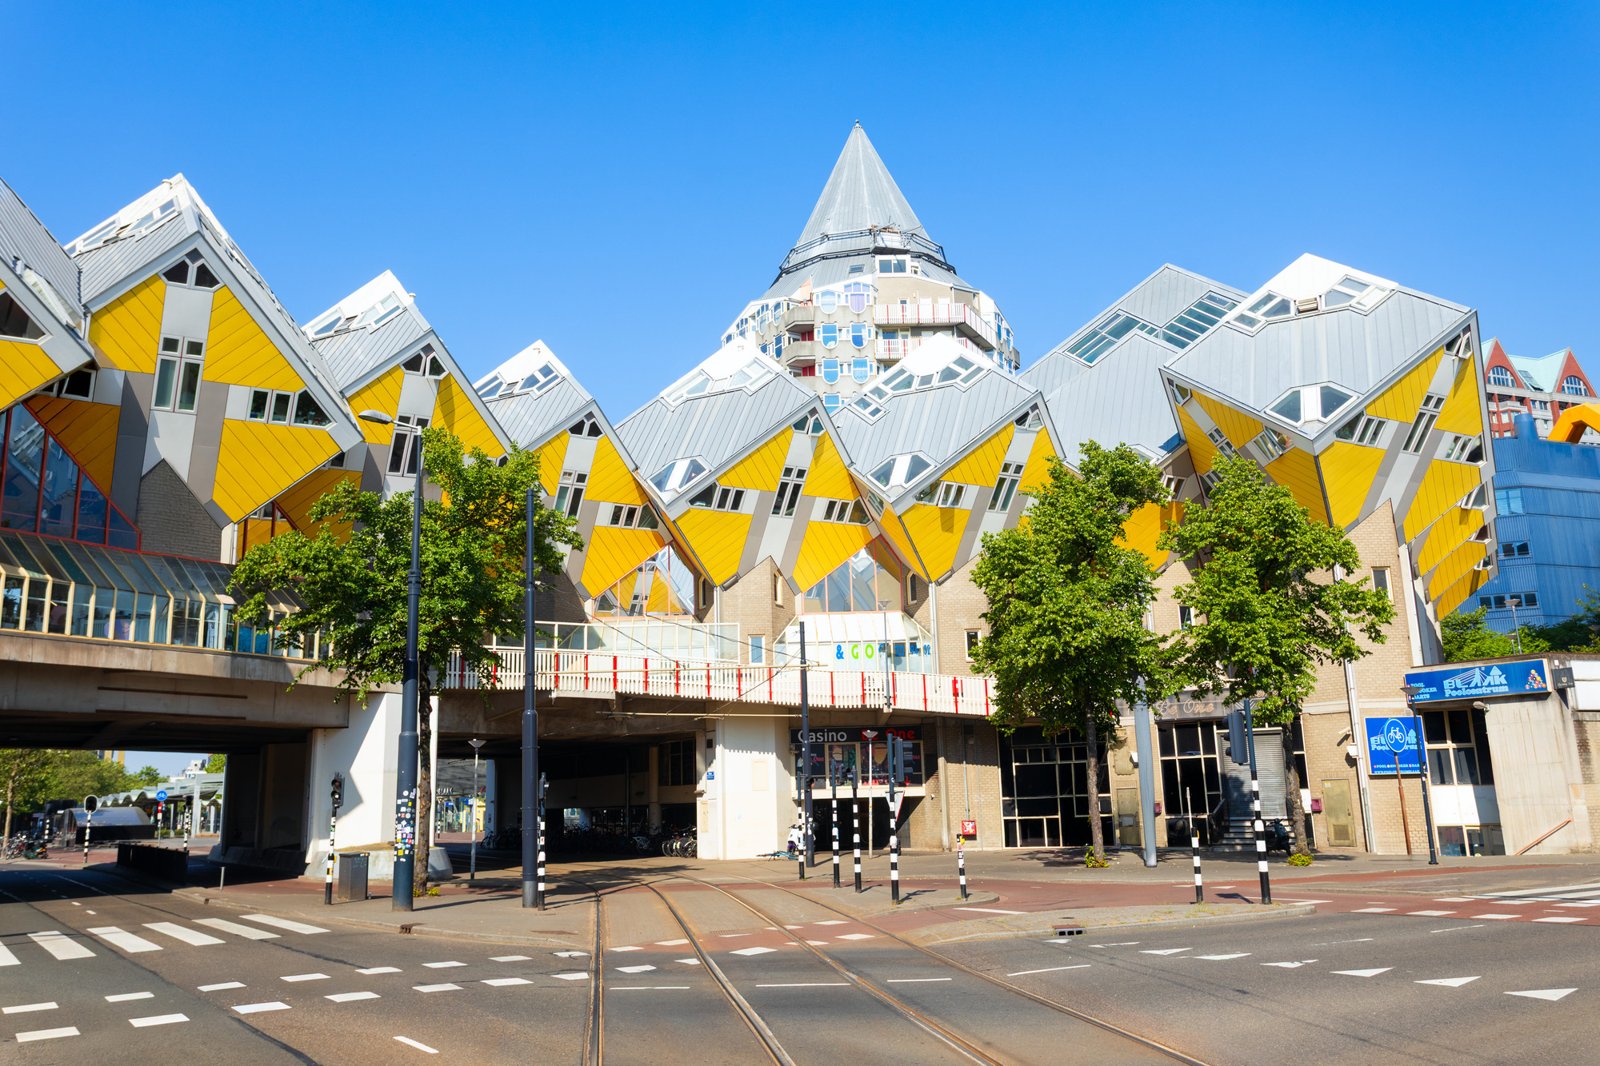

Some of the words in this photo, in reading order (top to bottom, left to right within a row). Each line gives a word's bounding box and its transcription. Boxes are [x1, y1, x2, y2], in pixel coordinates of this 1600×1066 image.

[836, 644, 844, 660] &
[1445, 685, 1509, 697] Poolcentrum
[1183, 699, 1215, 714] One
